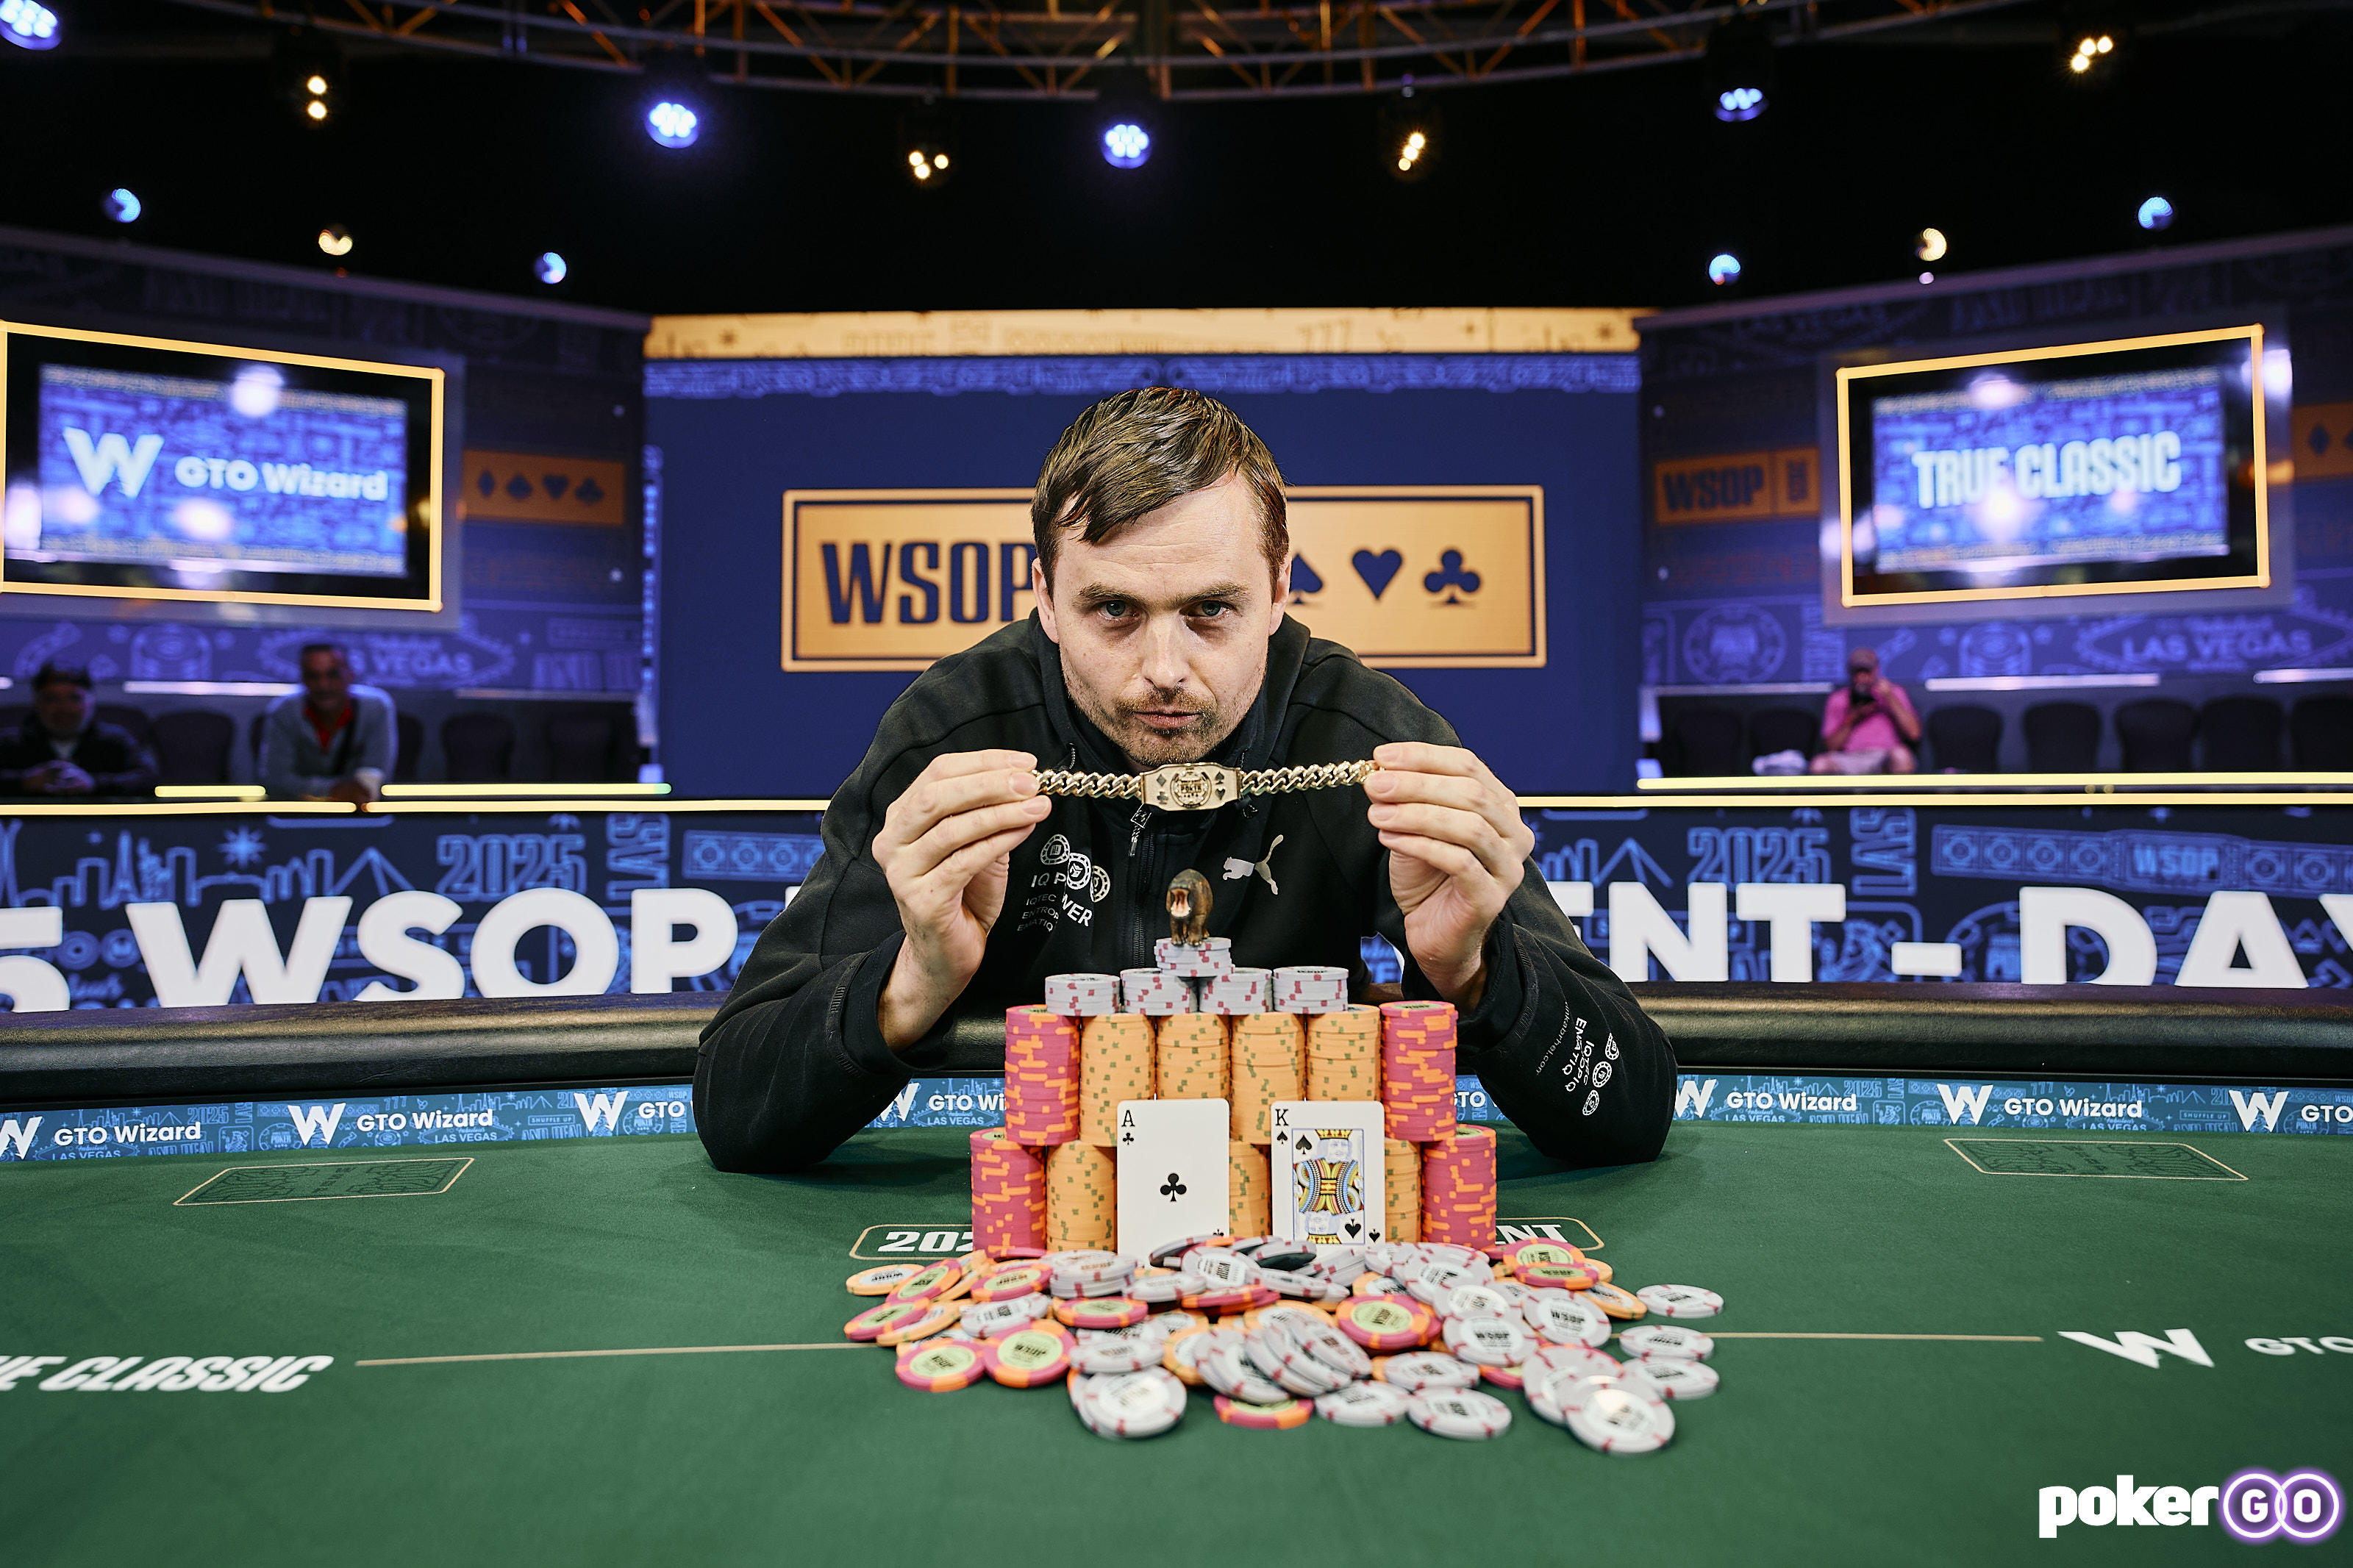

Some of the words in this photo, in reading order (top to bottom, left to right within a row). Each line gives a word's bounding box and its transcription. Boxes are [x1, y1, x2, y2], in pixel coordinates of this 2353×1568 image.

[175, 456, 258, 492] GTO
[261, 462, 388, 502] Wizard
[1913, 446, 2010, 509] TRUE
[2015, 430, 2181, 500] CLASSIC
[1663, 464, 1763, 511] WSOP
[821, 542, 1033, 625] WSOP
[2122, 635, 2187, 662] LAS
[2192, 629, 2313, 661] VEGAS
[437, 834, 587, 901] 2025
[1688, 827, 1832, 889] 2025
[2133, 844, 2219, 880] WSOP
[125, 887, 738, 1008] WSOP
[1843, 1080, 1882, 1098] 2025
[638, 1100, 685, 1119] GTO
[928, 1094, 973, 1111] GTO
[1727, 1092, 1774, 1109] GTO
[1778, 1092, 1857, 1111] Wizard
[2004, 1098, 2054, 1116] GTO
[2060, 1098, 2143, 1118] Wizard
[187, 1106, 229, 1125] 2025
[357, 1113, 407, 1132] GTO
[412, 1109, 493, 1130] Wizard
[927, 1117, 947, 1125] LAS
[950, 1117, 984, 1125] VEGAS
[1120, 1109, 1137, 1128] A
[1275, 1109, 1290, 1127] K
[1725, 1114, 1746, 1123] LAS
[1749, 1114, 1785, 1123] VEGAS
[2301, 1104, 2353, 1123] GTO
[54, 1127, 108, 1146] GTO
[114, 1122, 201, 1143] Wizard
[435, 1134, 457, 1143] LAS
[459, 1132, 498, 1142] VEGAS
[52, 1151, 76, 1160] LAS
[79, 1150, 121, 1159] VEGAS
[877, 1231, 973, 1252] 20
[1551, 1311, 1585, 1325] WSOP
[39, 1354, 335, 1393] CLASSIC
